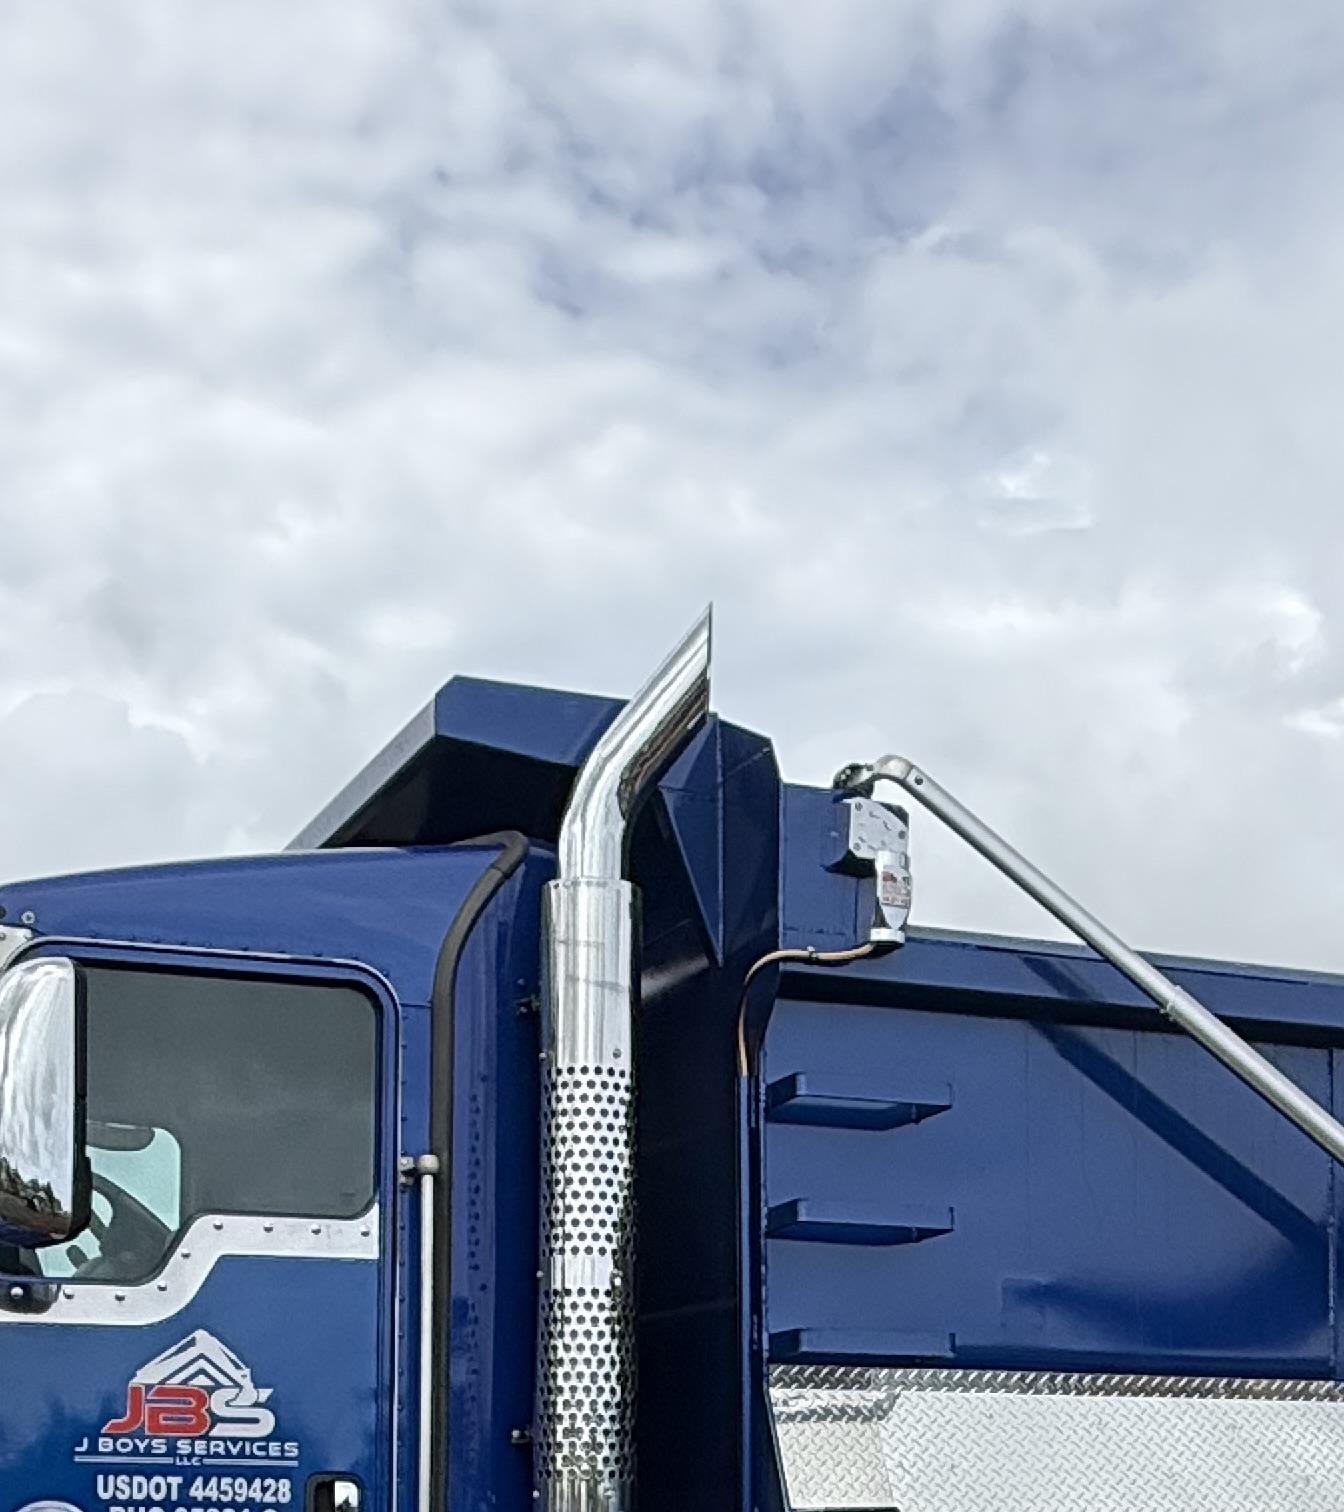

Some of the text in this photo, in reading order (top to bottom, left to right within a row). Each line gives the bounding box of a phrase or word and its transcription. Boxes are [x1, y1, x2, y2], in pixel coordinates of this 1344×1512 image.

[101, 1384, 276, 1438] JBS
[74, 1437, 300, 1458] J BOYS SERVICES
[174, 1456, 202, 1467] LLC
[96, 1474, 292, 1503] USDOT 4459428
